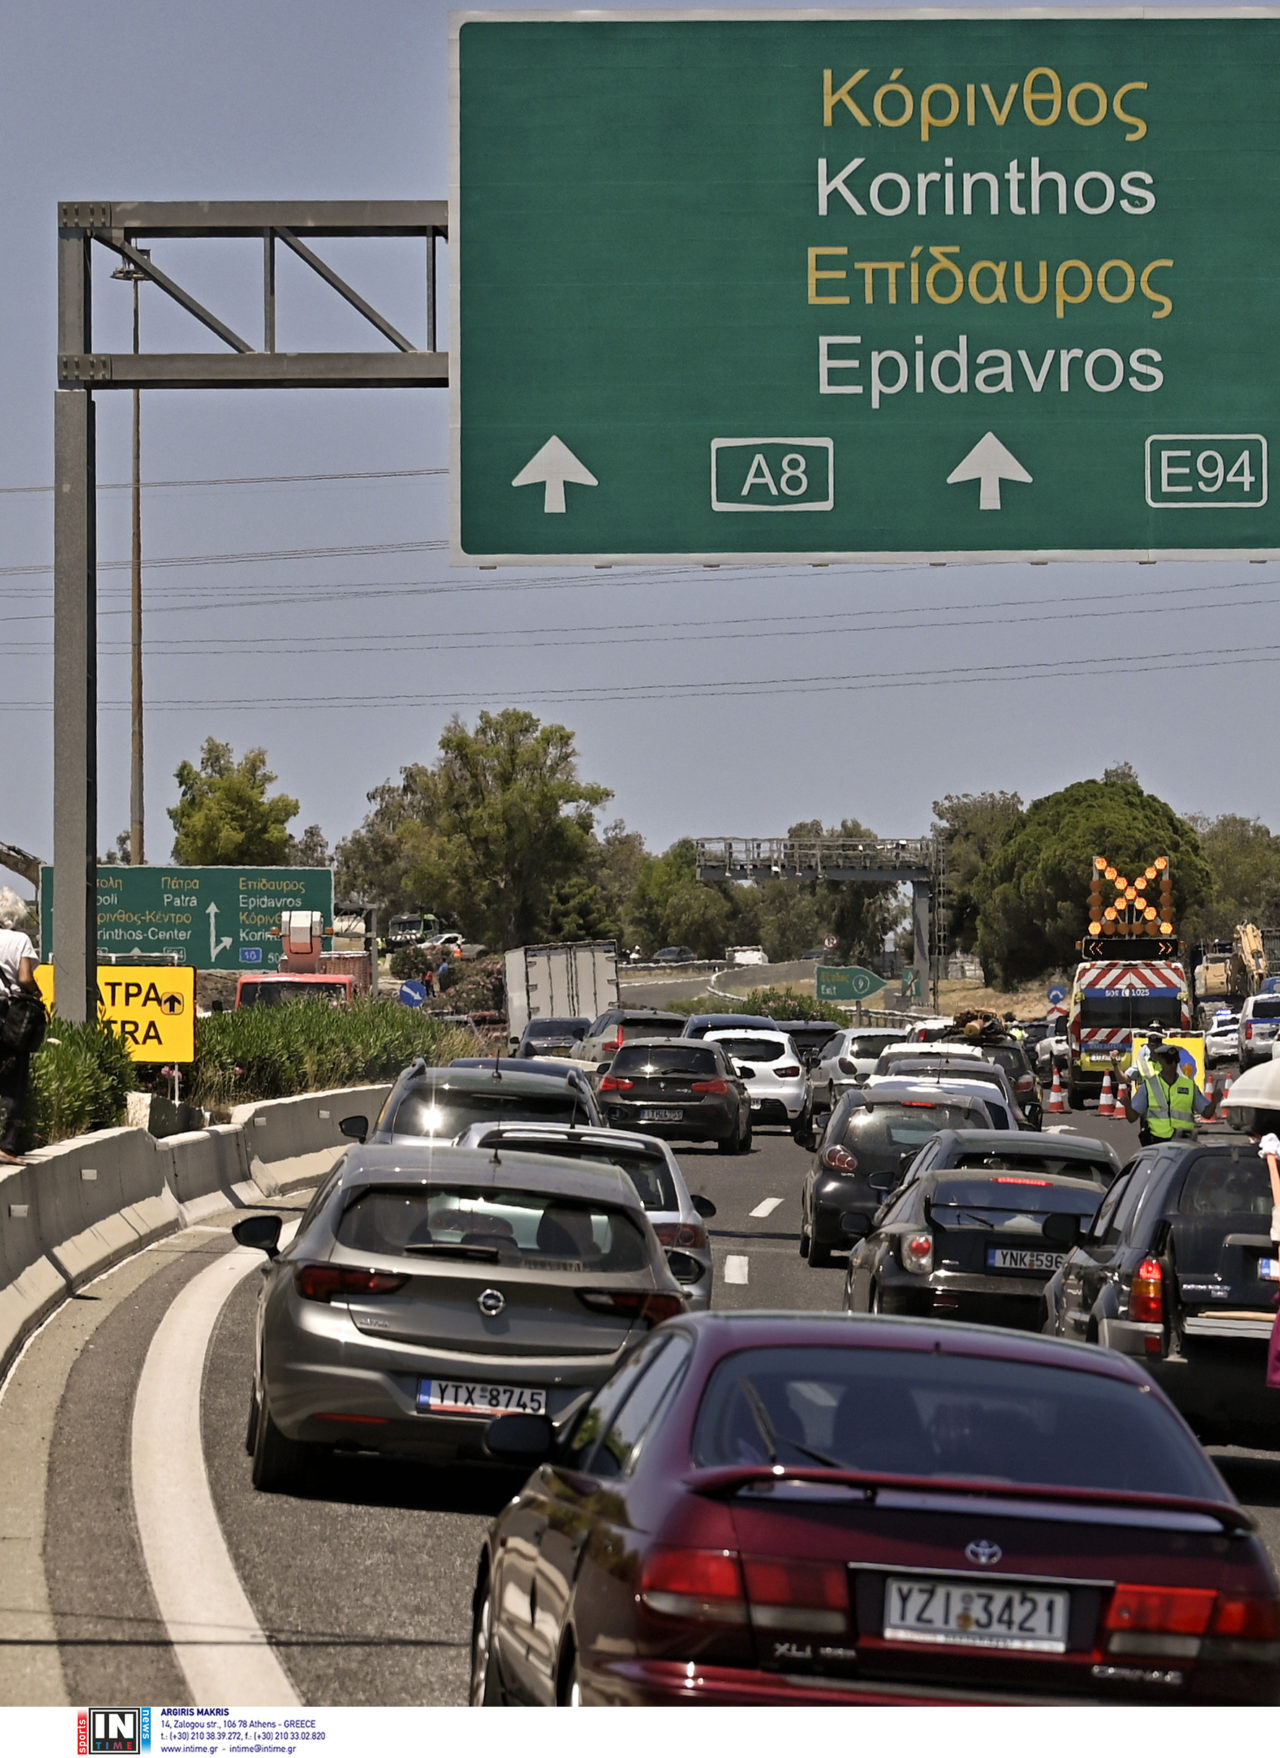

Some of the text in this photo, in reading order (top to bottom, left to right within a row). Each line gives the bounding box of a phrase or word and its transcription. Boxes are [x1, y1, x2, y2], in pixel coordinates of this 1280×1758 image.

[823, 67, 1148, 142] Κόρινθος
[817, 156, 1156, 217] Korinthos
[807, 245, 1174, 319] Επίδαυρος
[818, 334, 1164, 409] Epidavros
[740, 449, 1256, 497] A8 E94
[161, 876, 200, 891] Πάτρα
[97, 893, 118, 906] poli
[163, 893, 198, 907] Patra
[239, 894, 302, 910] Epidavros
[97, 909, 192, 925] ρινθος-Κέντρο
[97, 927, 192, 941] rinthos-Center
[244, 950, 257, 960] 10
[1131, 988, 1150, 997] 1025
[1000, 1250, 1065, 1269] YNK-596
